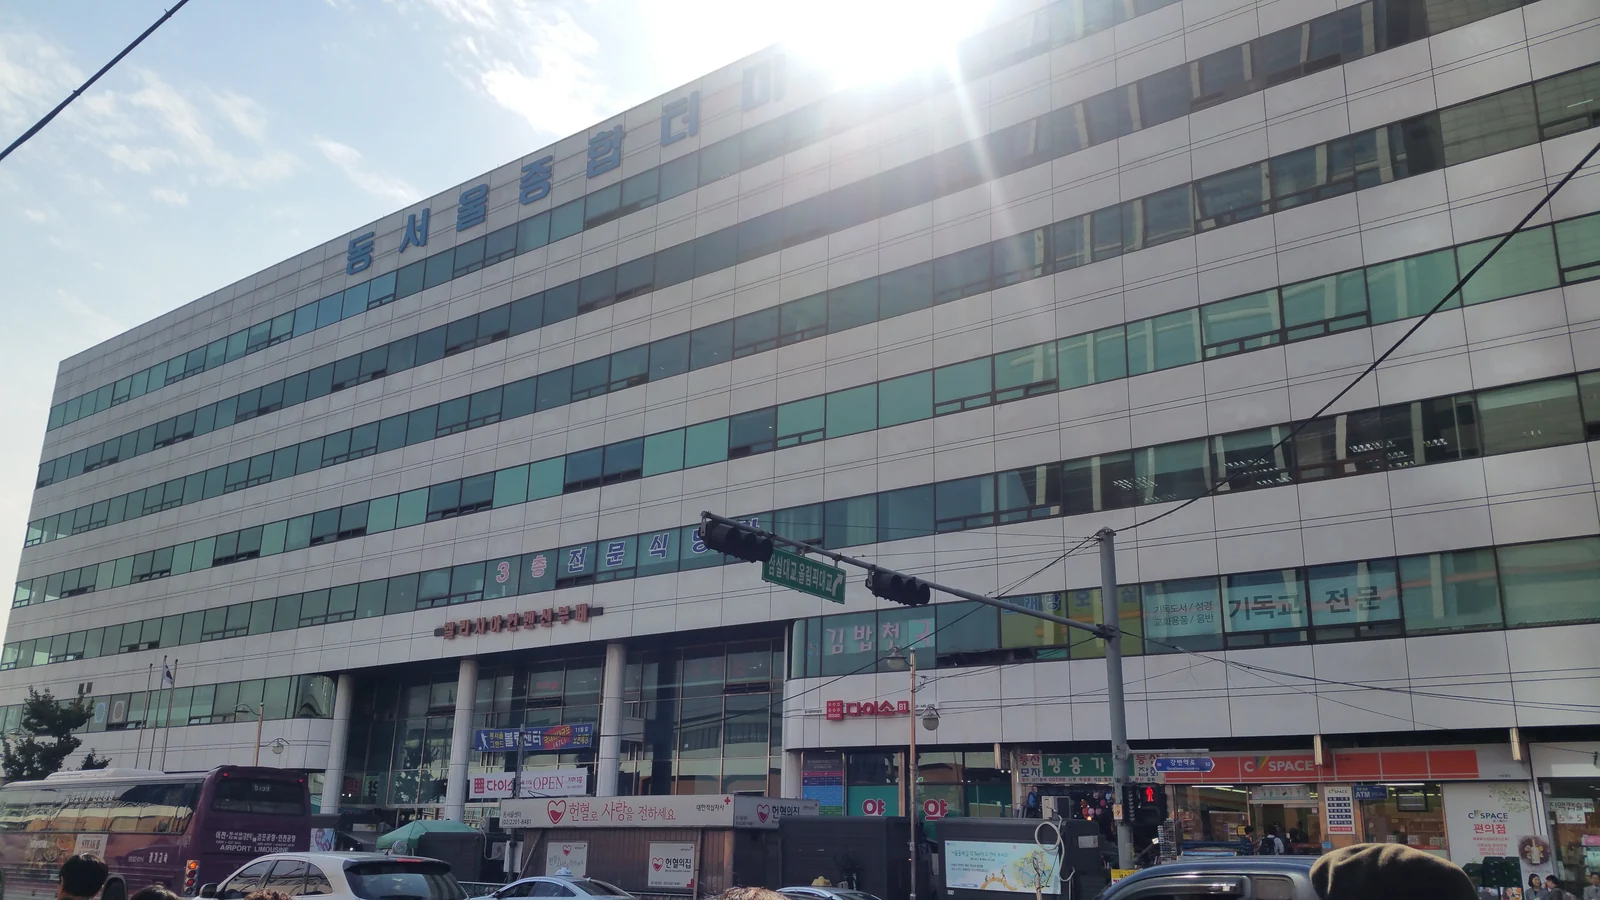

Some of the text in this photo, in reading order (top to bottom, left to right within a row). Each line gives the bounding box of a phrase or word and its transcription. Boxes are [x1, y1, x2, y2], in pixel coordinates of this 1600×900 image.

[1154, 604, 1187, 614] 기독도서
[1195, 601, 1213, 611] 성경
[1228, 586, 1381, 620] 기독교 전문
[1154, 616, 1188, 626] 교회용품
[1197, 614, 1214, 624] 음반
[846, 700, 895, 716] 다이소
[1020, 755, 1040, 766] 등산
[1268, 760, 1314, 771] SPACE
[1021, 768, 1041, 777] 모자
[533, 776, 564, 790] OPEN
[569, 801, 676, 821] 헌혈로 사랑을 전하세요
[1473, 823, 1507, 834] 편의점
[665, 857, 691, 869] 헌혈의집
